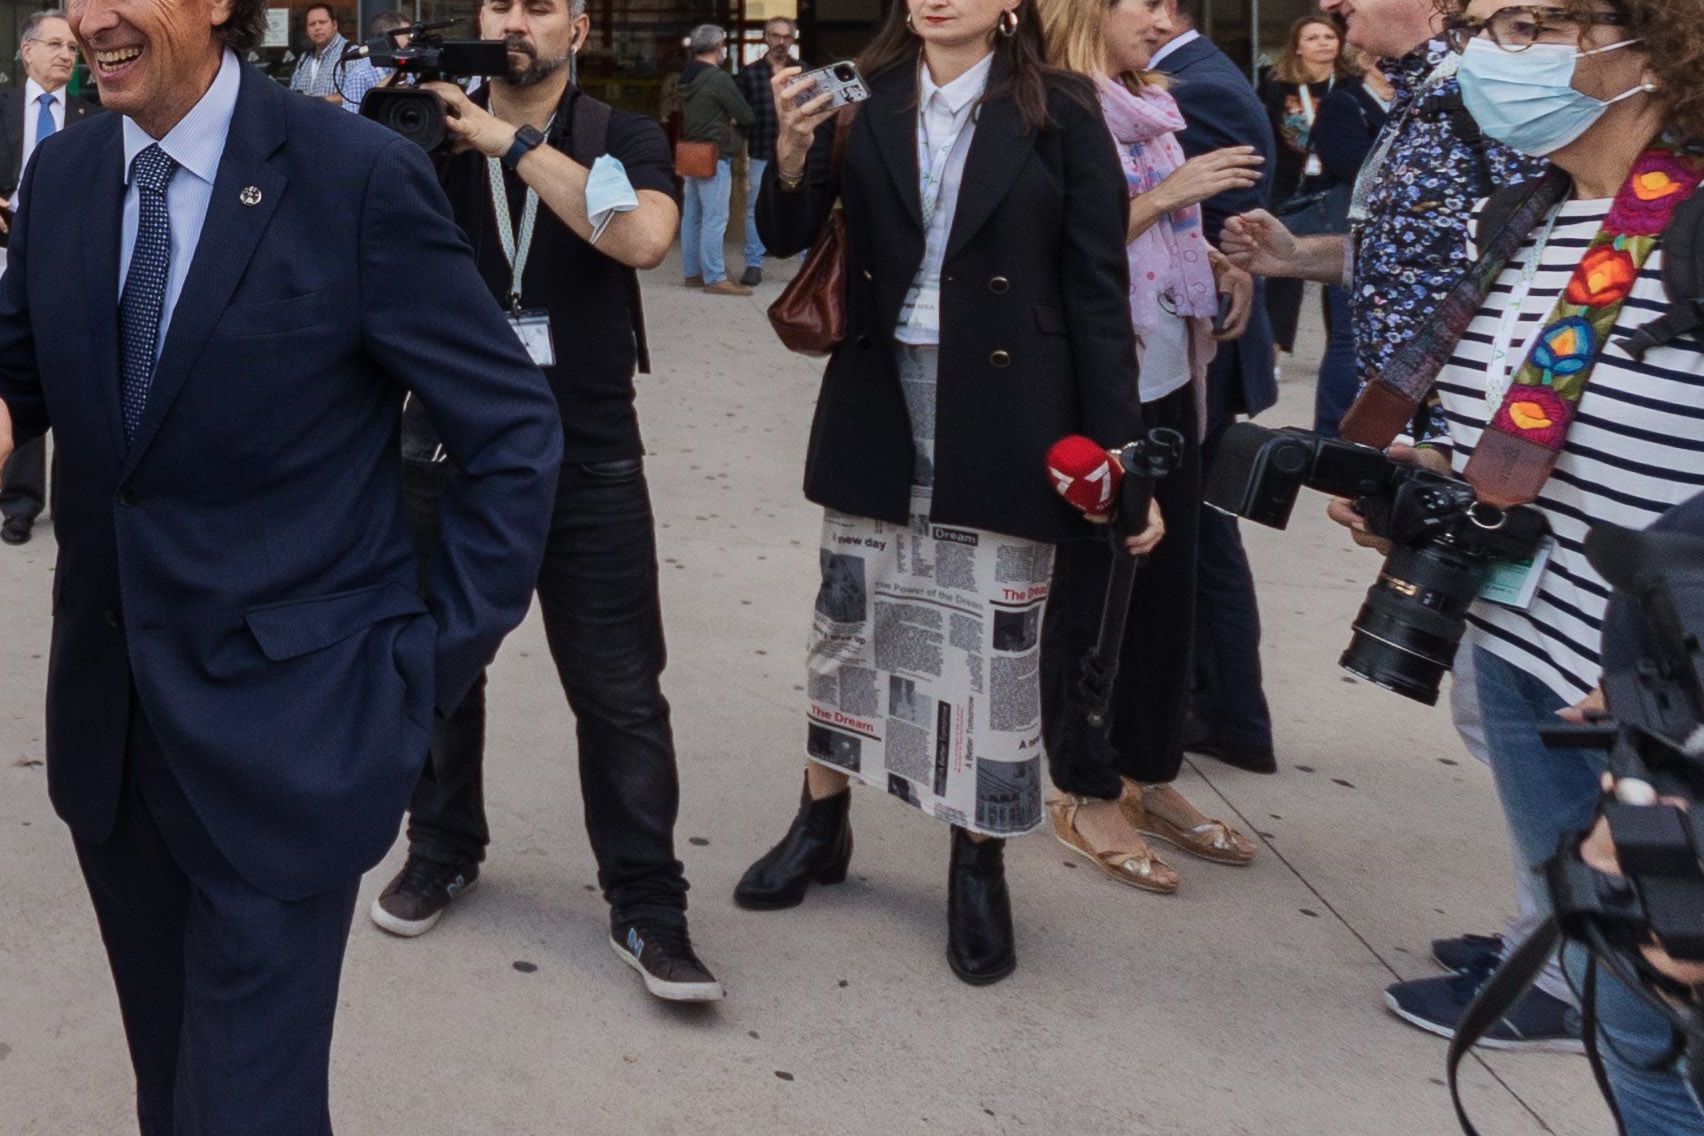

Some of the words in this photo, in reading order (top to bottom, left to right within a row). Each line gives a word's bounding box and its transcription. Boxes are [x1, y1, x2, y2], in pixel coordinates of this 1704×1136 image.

[865, 537, 886, 552] day
[1003, 588, 1026, 601] The
[811, 703, 832, 720] The
[835, 711, 874, 733] Dream
